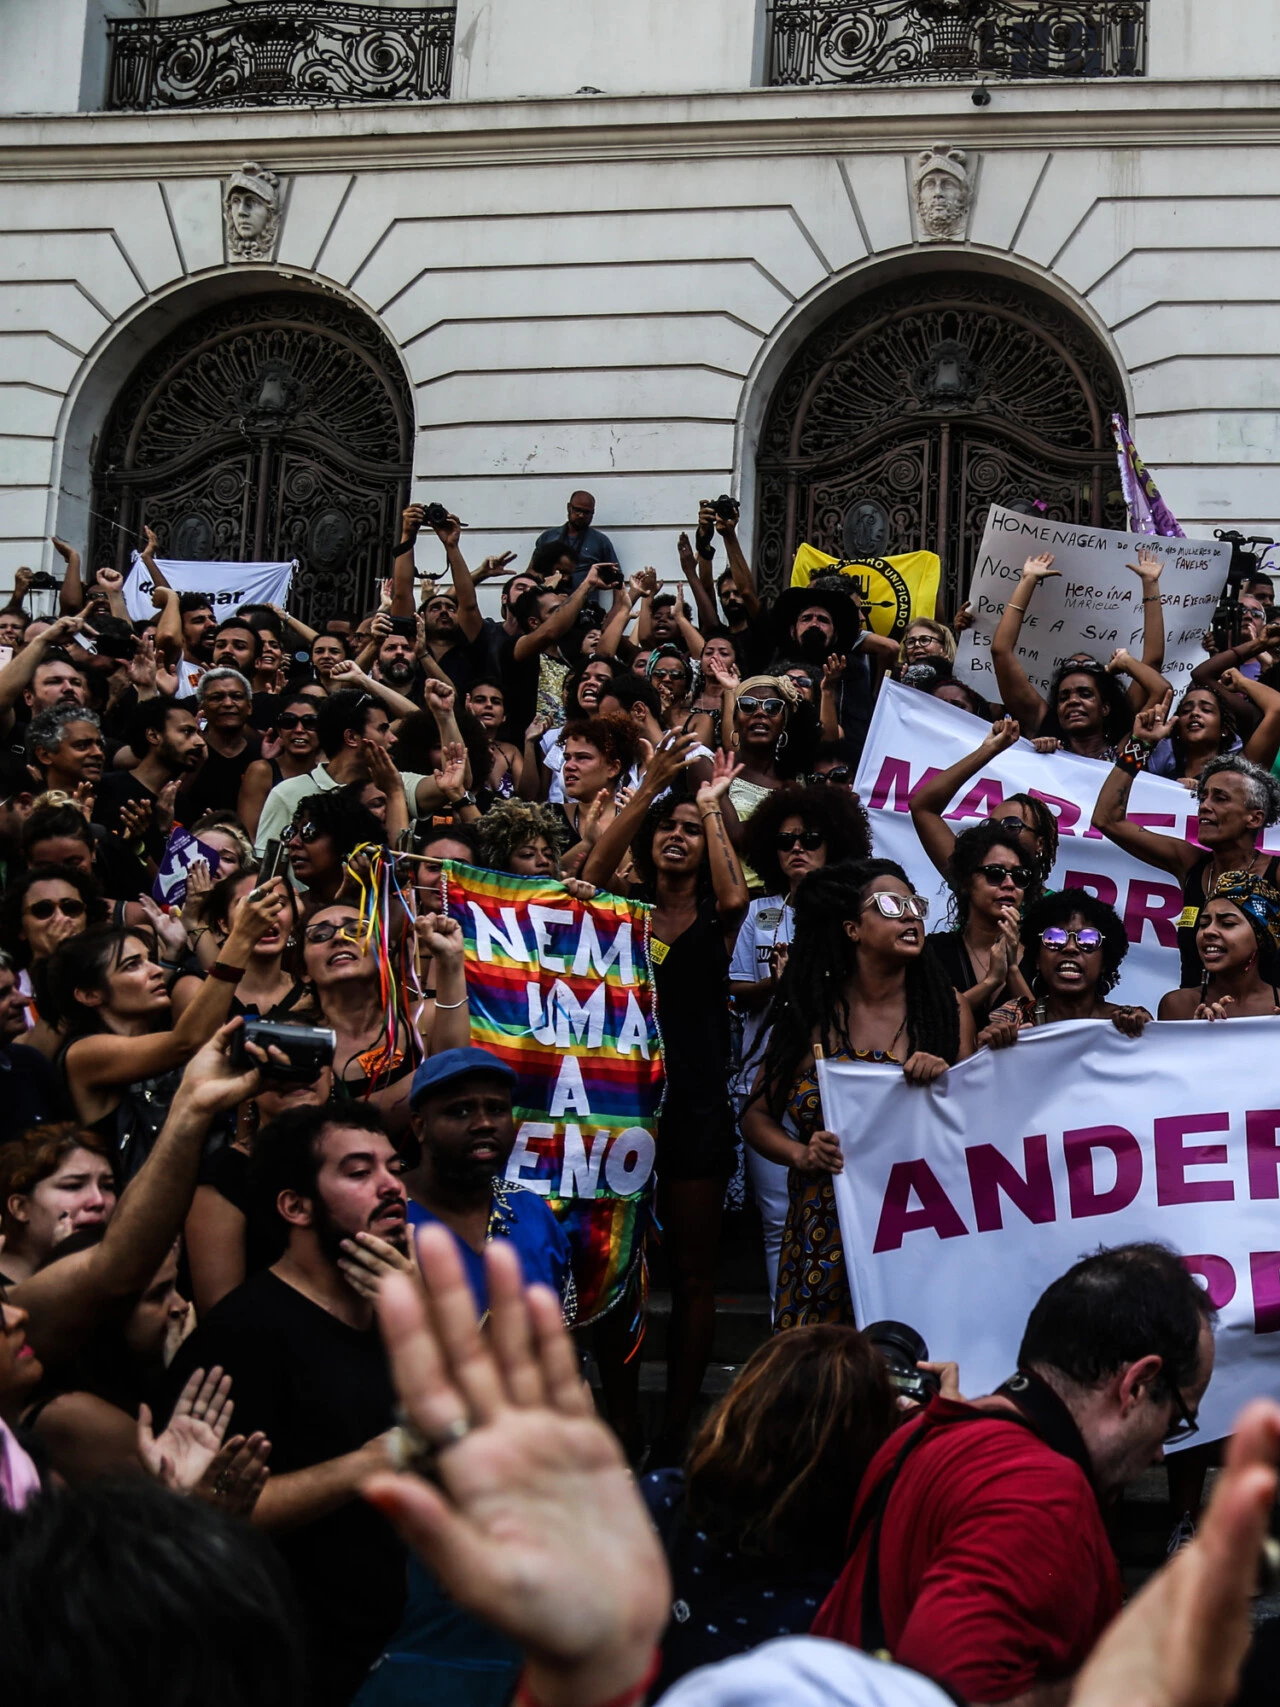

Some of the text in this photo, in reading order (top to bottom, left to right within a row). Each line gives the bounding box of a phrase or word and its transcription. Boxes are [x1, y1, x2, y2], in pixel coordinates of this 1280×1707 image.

[992, 511, 1107, 550] HOMENAGEM
[884, 567, 909, 628] UNIFICADO
[1049, 620, 1065, 633] A
[1079, 625, 1118, 641] SUA
[466, 900, 635, 986] NEM
[526, 978, 650, 1061] UMA
[549, 1055, 591, 1118] A
